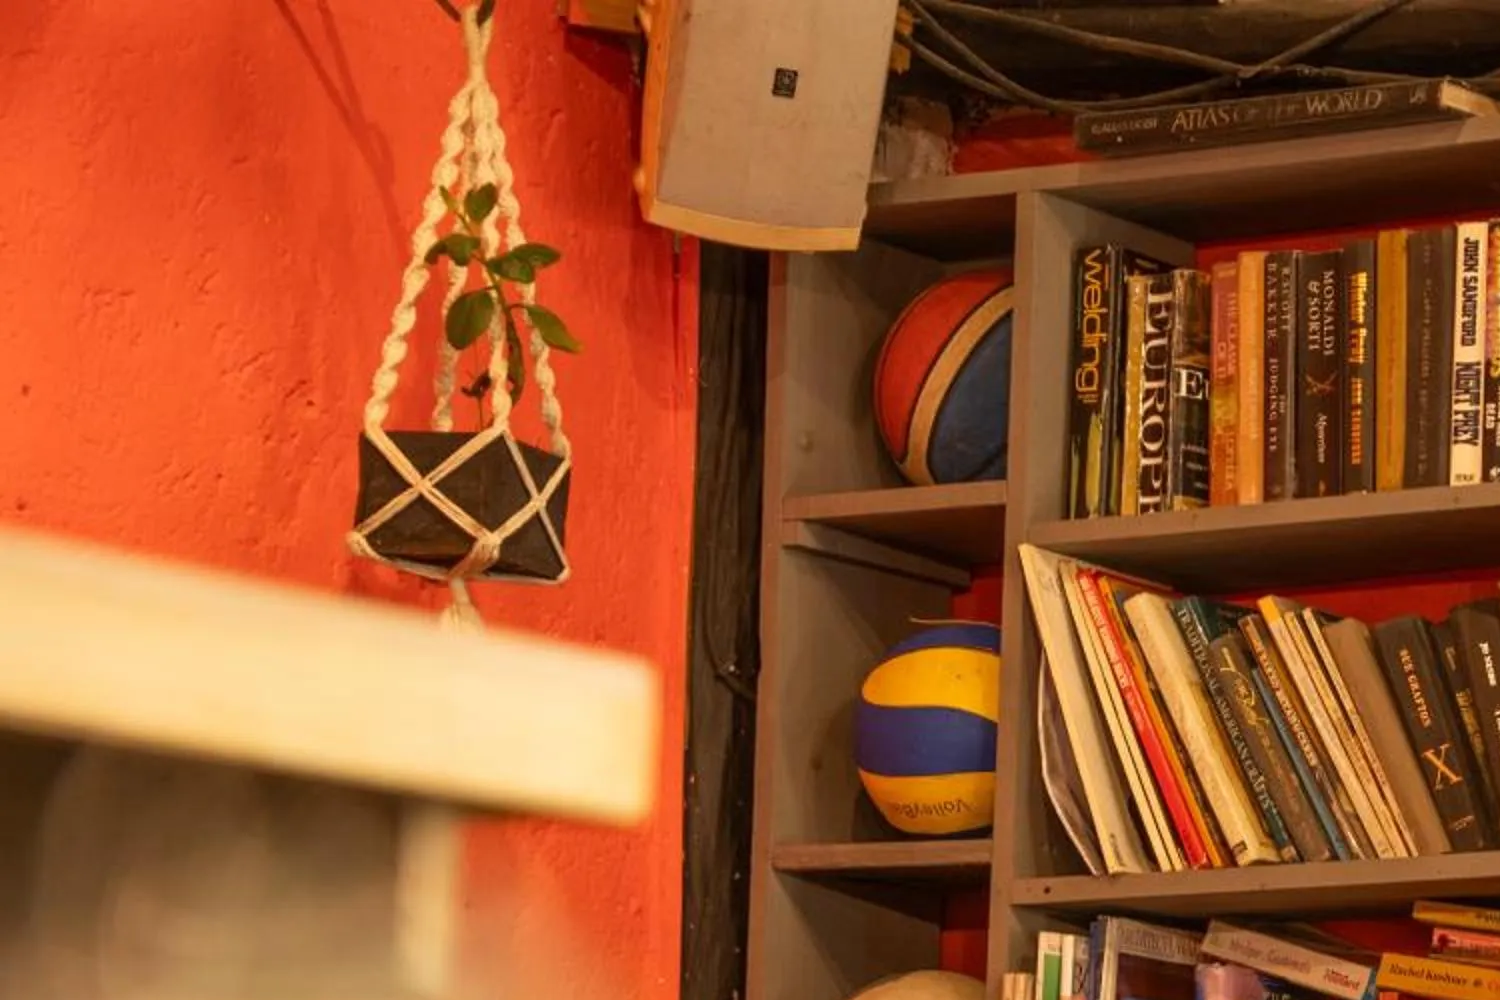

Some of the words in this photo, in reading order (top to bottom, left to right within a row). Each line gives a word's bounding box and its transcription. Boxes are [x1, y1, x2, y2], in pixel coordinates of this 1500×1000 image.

[1171, 105, 1231, 133] ATLAS
[1304, 88, 1383, 116] WORLD
[1464, 237, 1480, 272] JOHN
[1074, 248, 1109, 393] welding
[1308, 296, 1320, 350] SORTI
[1322, 269, 1336, 355] MONALDI
[1461, 277, 1477, 346] SANDFORD
[1454, 410, 1480, 446] PREY
[1422, 743, 1463, 790] X
